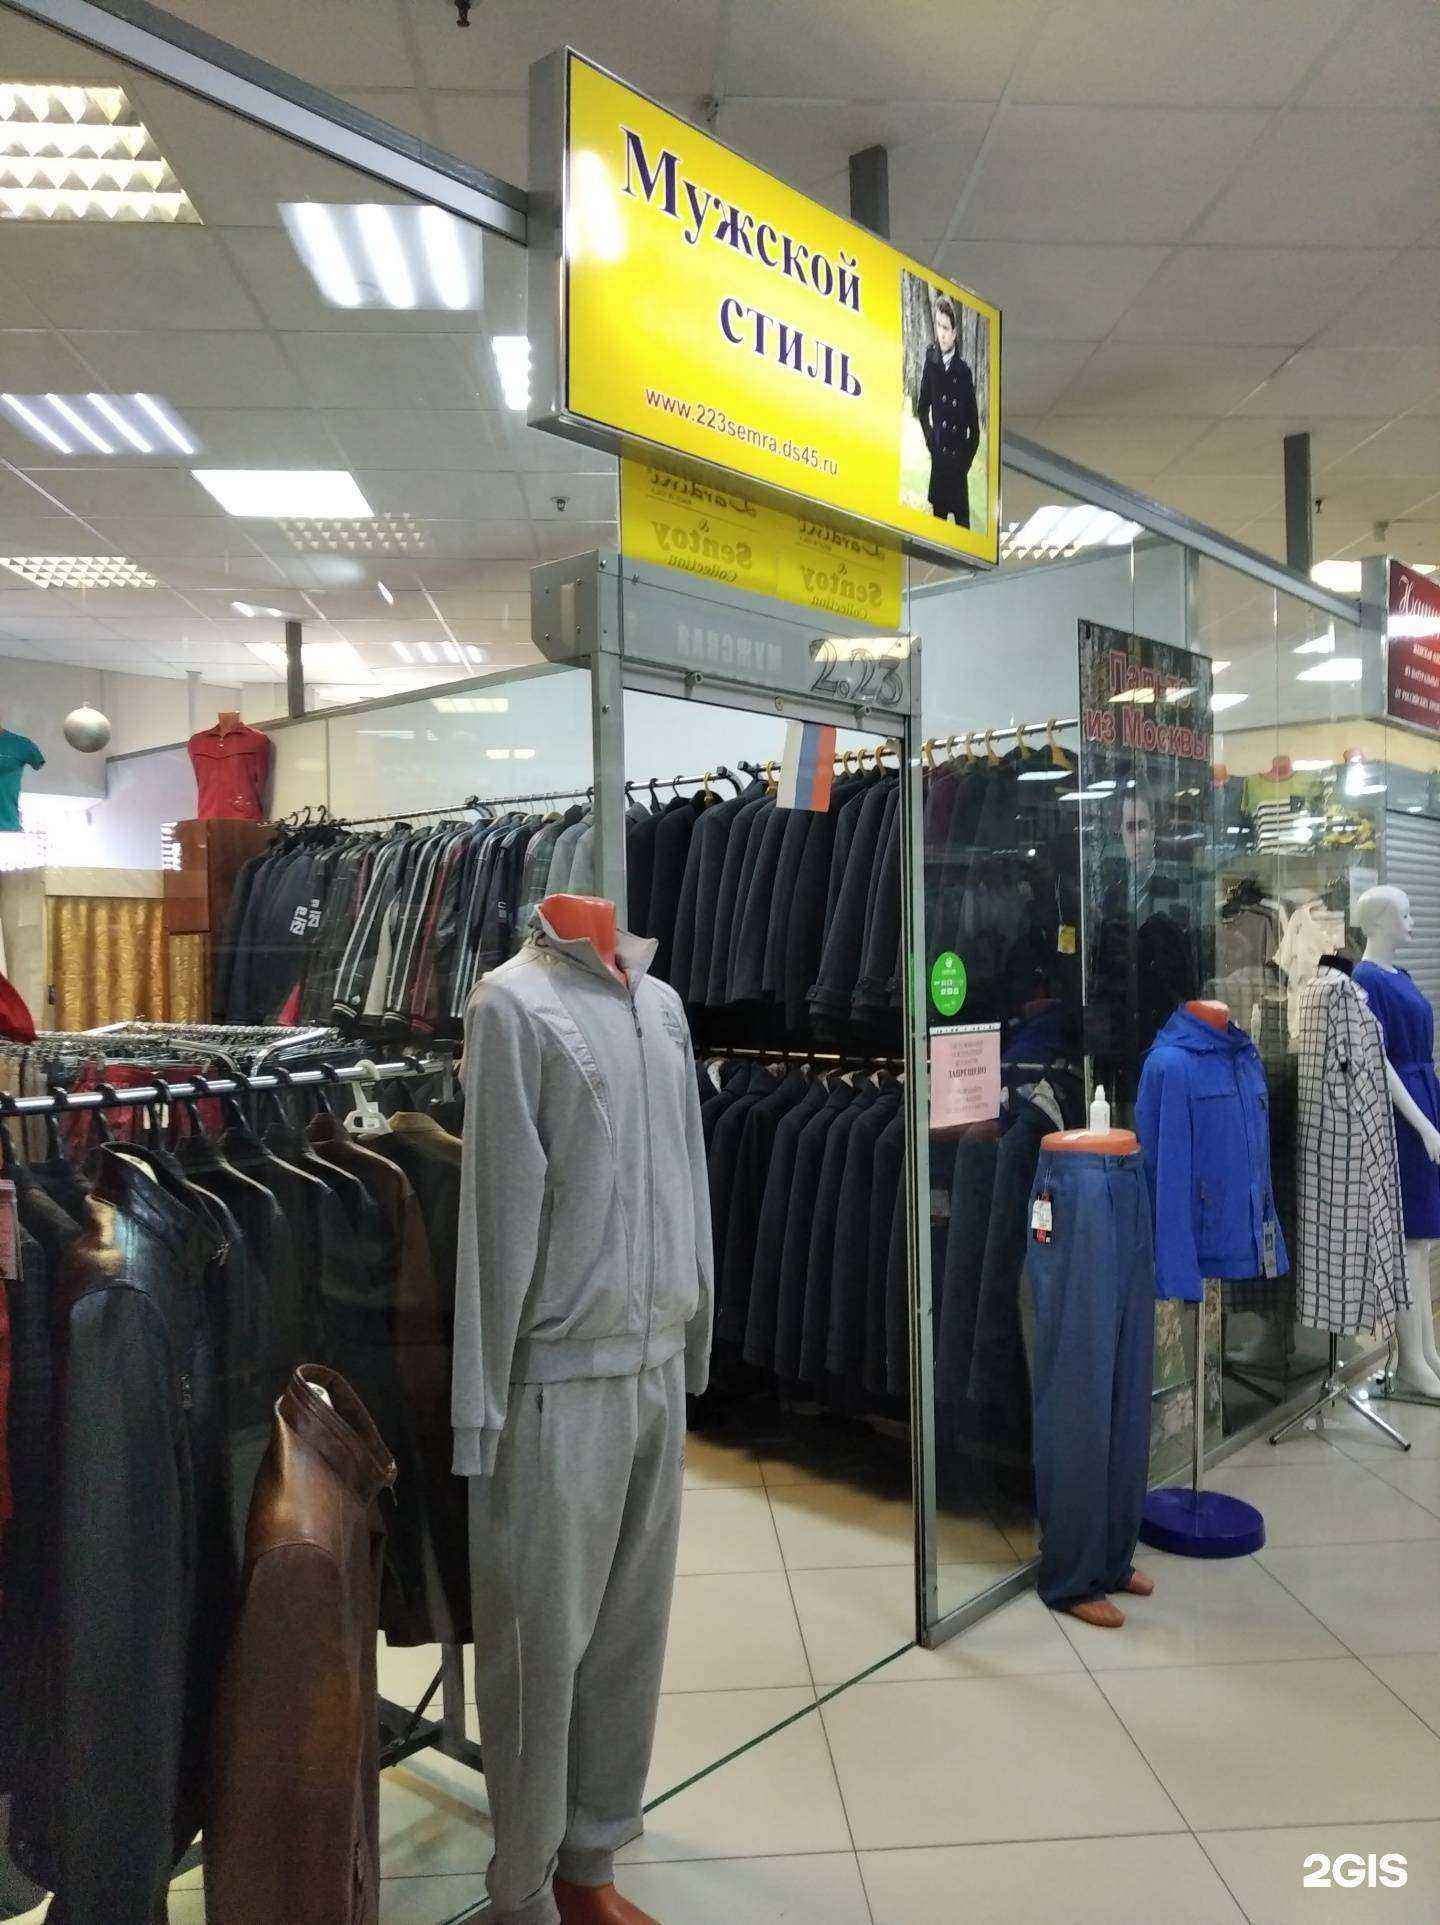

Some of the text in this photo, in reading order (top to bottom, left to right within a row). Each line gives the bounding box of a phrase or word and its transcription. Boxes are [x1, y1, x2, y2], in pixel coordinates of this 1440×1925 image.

[620, 125, 861, 313] Мужской
[720, 298, 863, 397] стиль
[645, 388, 840, 475] www.223semra.ds45.ru
[1122, 702, 1209, 760] Москвы
